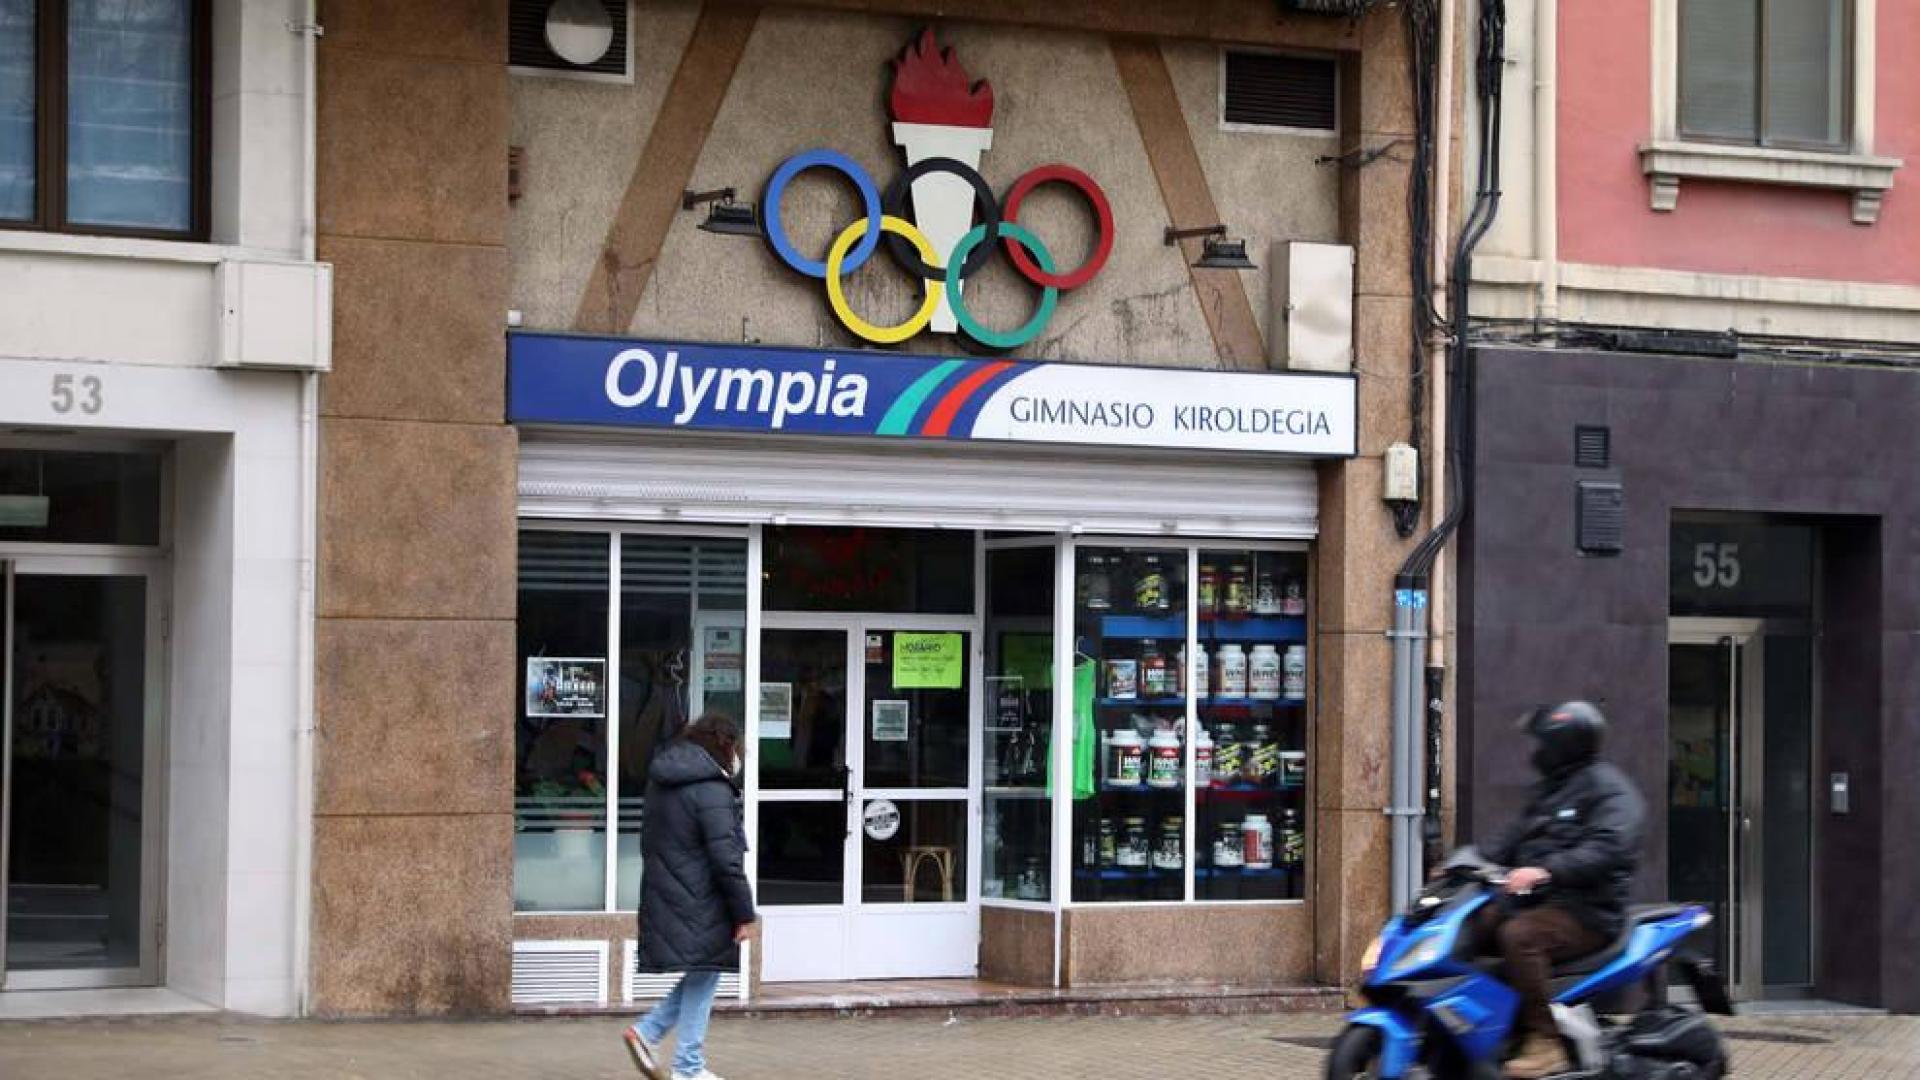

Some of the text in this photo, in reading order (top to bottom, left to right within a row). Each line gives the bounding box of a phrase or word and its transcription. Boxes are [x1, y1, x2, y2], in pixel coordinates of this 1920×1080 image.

[51, 373, 103, 414] 53
[605, 348, 868, 429] Olympia
[1009, 396, 1331, 435] GIMNASIO KIROLDEGIA
[1693, 542, 1740, 588] 55
